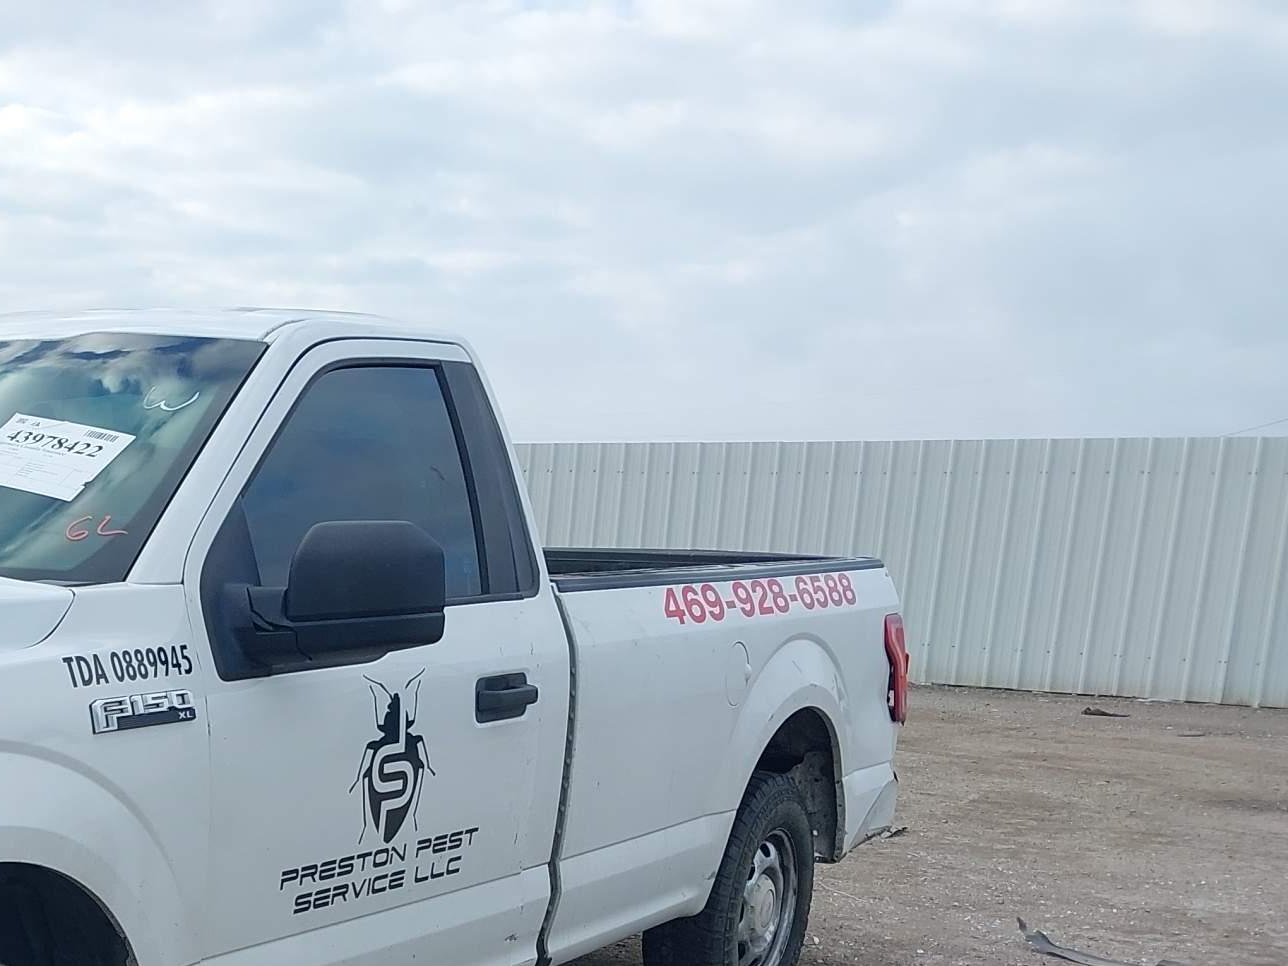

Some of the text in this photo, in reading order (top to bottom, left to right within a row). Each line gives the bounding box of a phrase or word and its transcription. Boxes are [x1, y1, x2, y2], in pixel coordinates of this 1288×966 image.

[7, 430, 103, 458] 43978422
[664, 573, 857, 625] 469-928-6588
[62, 644, 193, 688] TDA 0889945
[178, 710, 194, 719] XL
[279, 827, 479, 891] PRESTON PEST
[293, 855, 463, 915] SERVICE LLC
